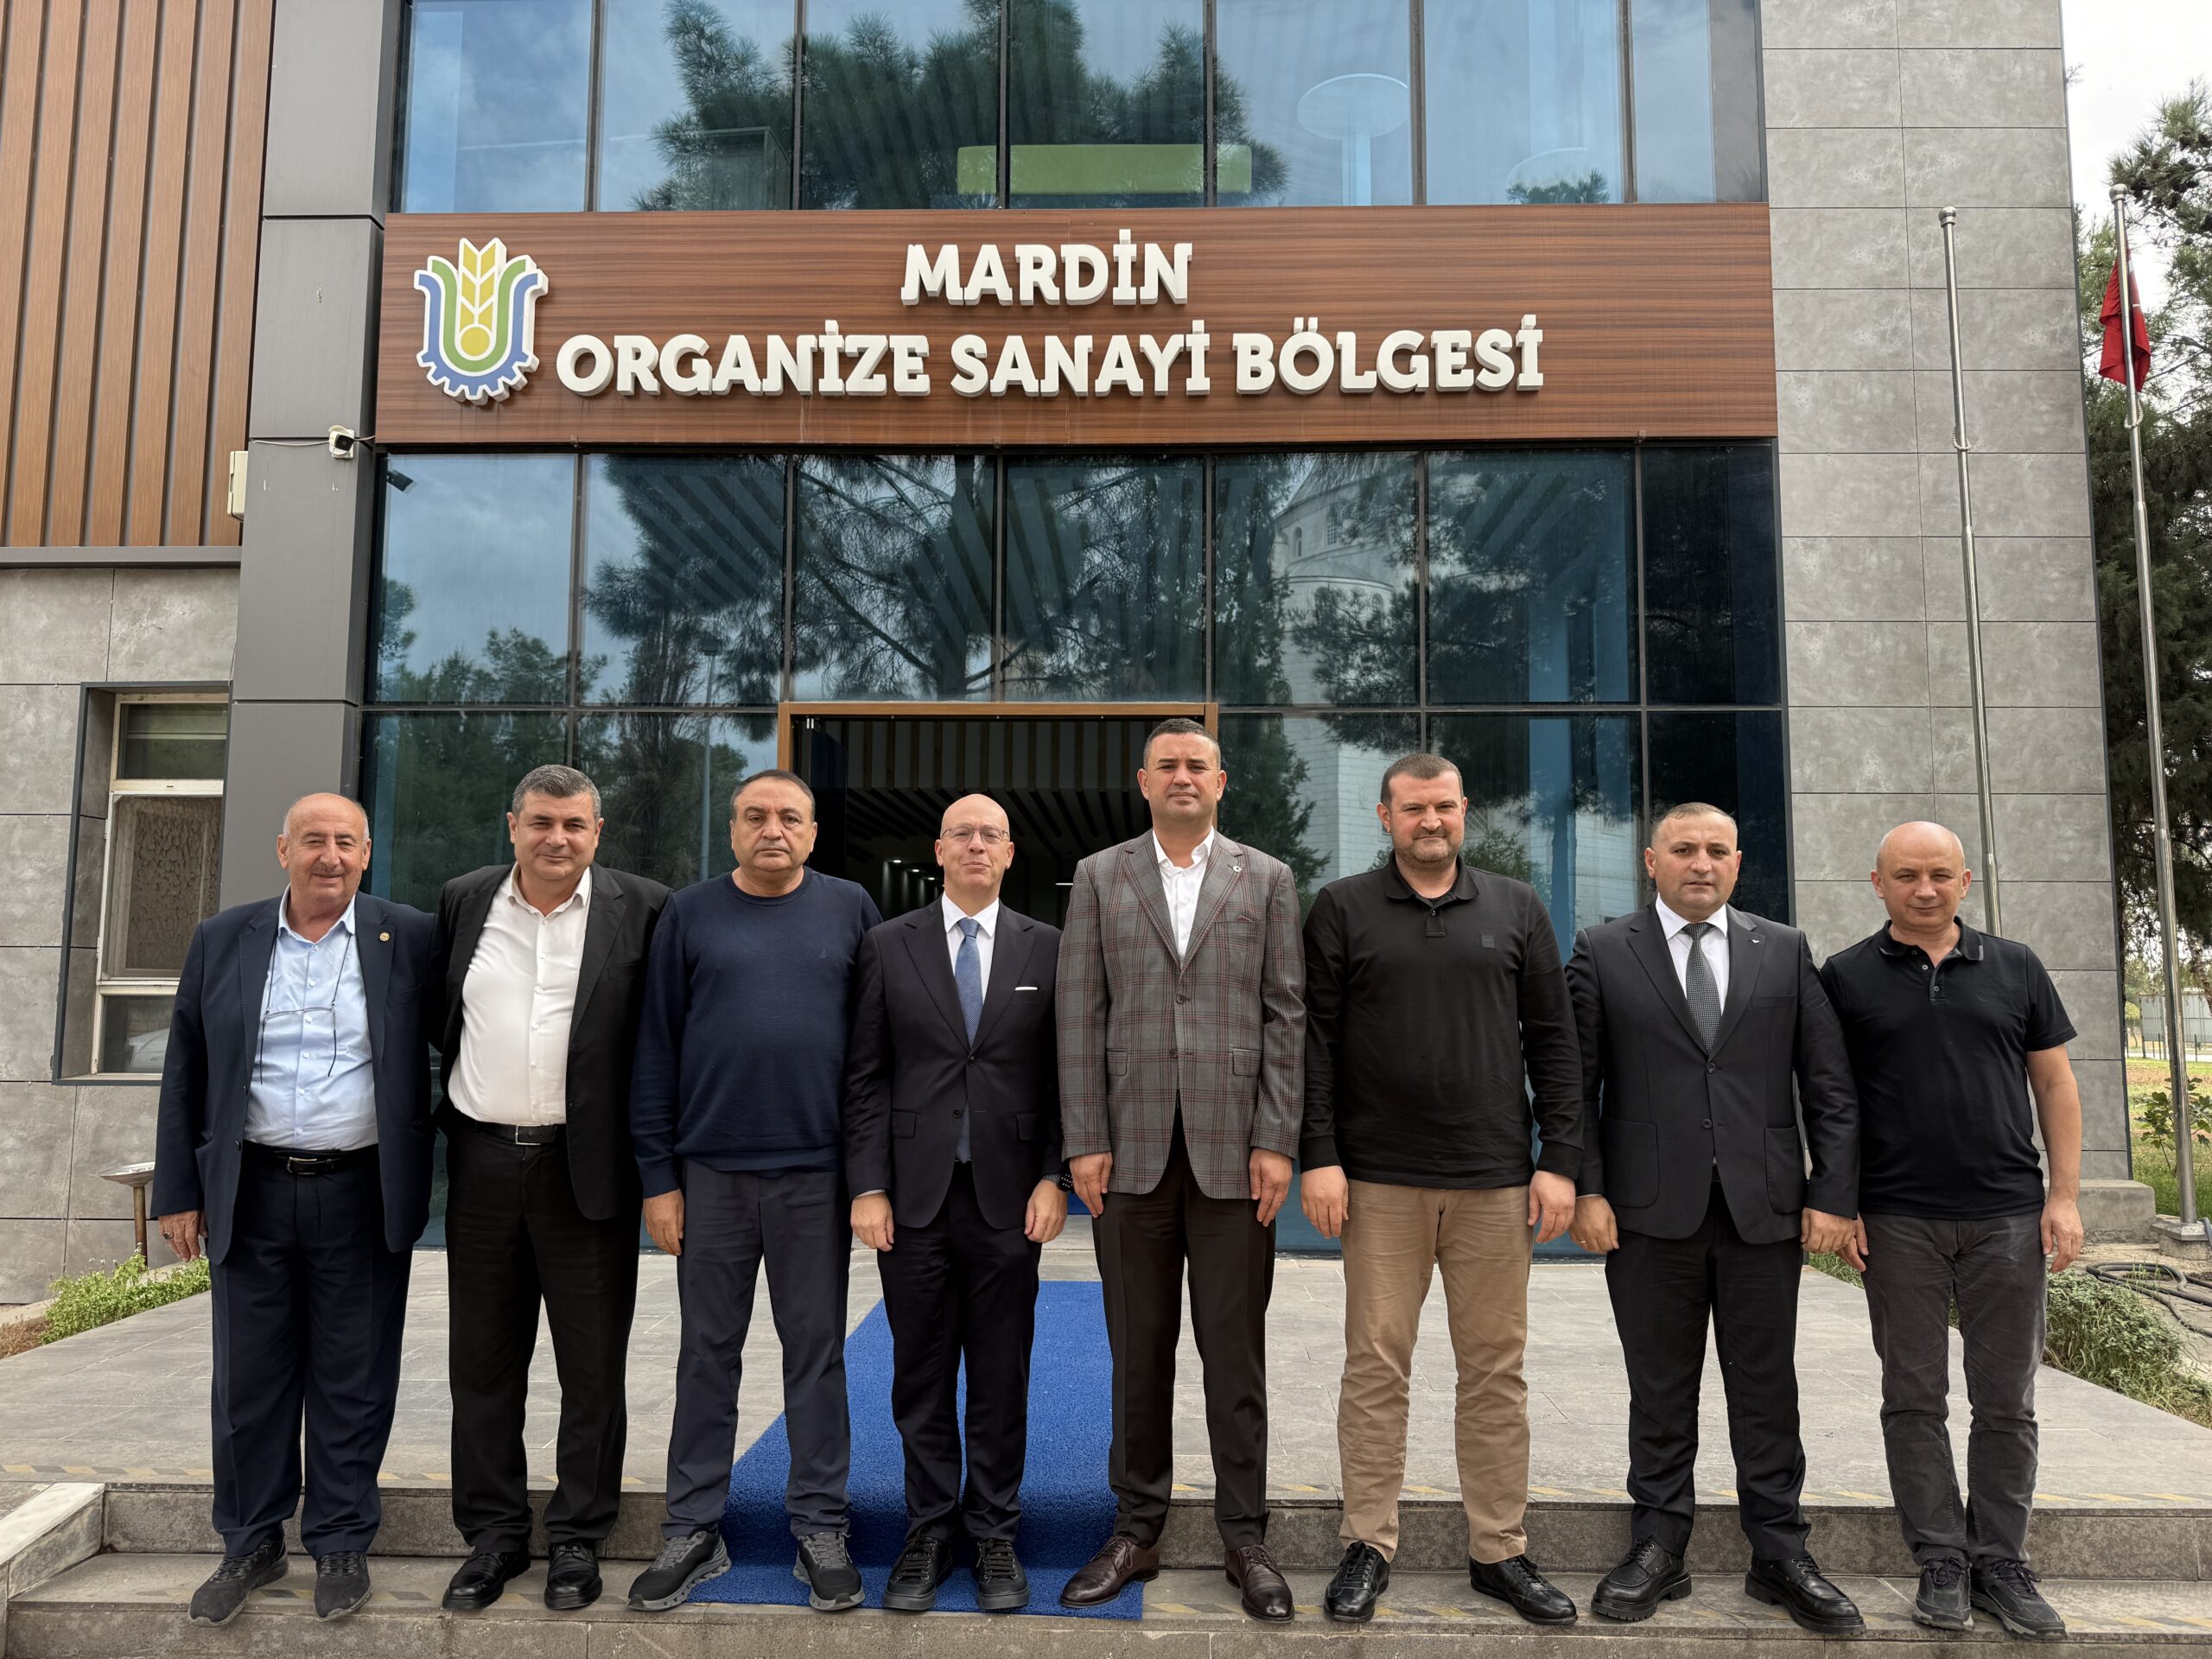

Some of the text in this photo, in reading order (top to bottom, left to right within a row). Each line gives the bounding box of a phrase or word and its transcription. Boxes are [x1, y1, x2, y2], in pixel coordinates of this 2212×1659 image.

[901, 229, 1192, 306] MARDİN
[556, 314, 1544, 397] ORGANİZE SANAYİ BÖLGESİ
